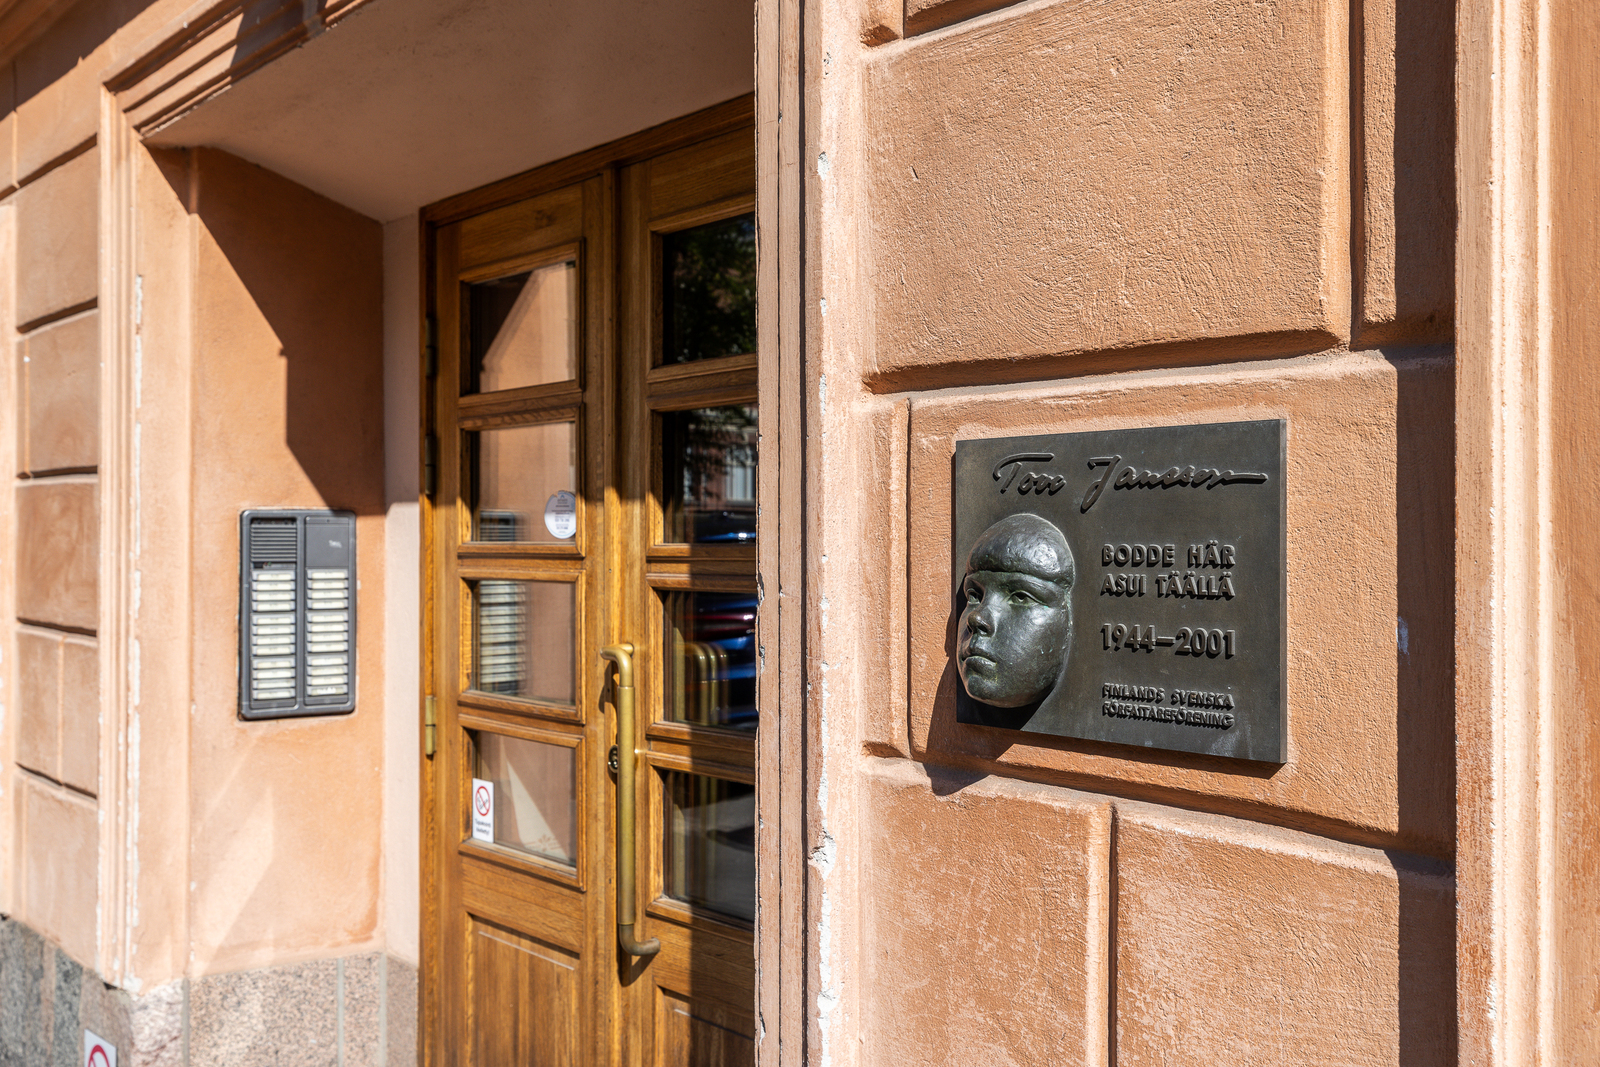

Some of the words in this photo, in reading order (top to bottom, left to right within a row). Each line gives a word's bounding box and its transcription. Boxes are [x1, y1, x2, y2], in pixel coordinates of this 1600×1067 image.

[1080, 454, 1269, 514] Jansson
[1102, 543, 1175, 567] BODDE
[1187, 539, 1236, 568] HÄR
[1100, 573, 1147, 597] ASUI
[1155, 570, 1236, 600] TÄÄLLÄ
[1100, 622, 1236, 659] 1944–2001
[1102, 682, 1166, 704] FINLANDS
[1170, 688, 1235, 710] SVENSKA
[1102, 699, 1235, 729] FÖRFATTAREFÖRENING
